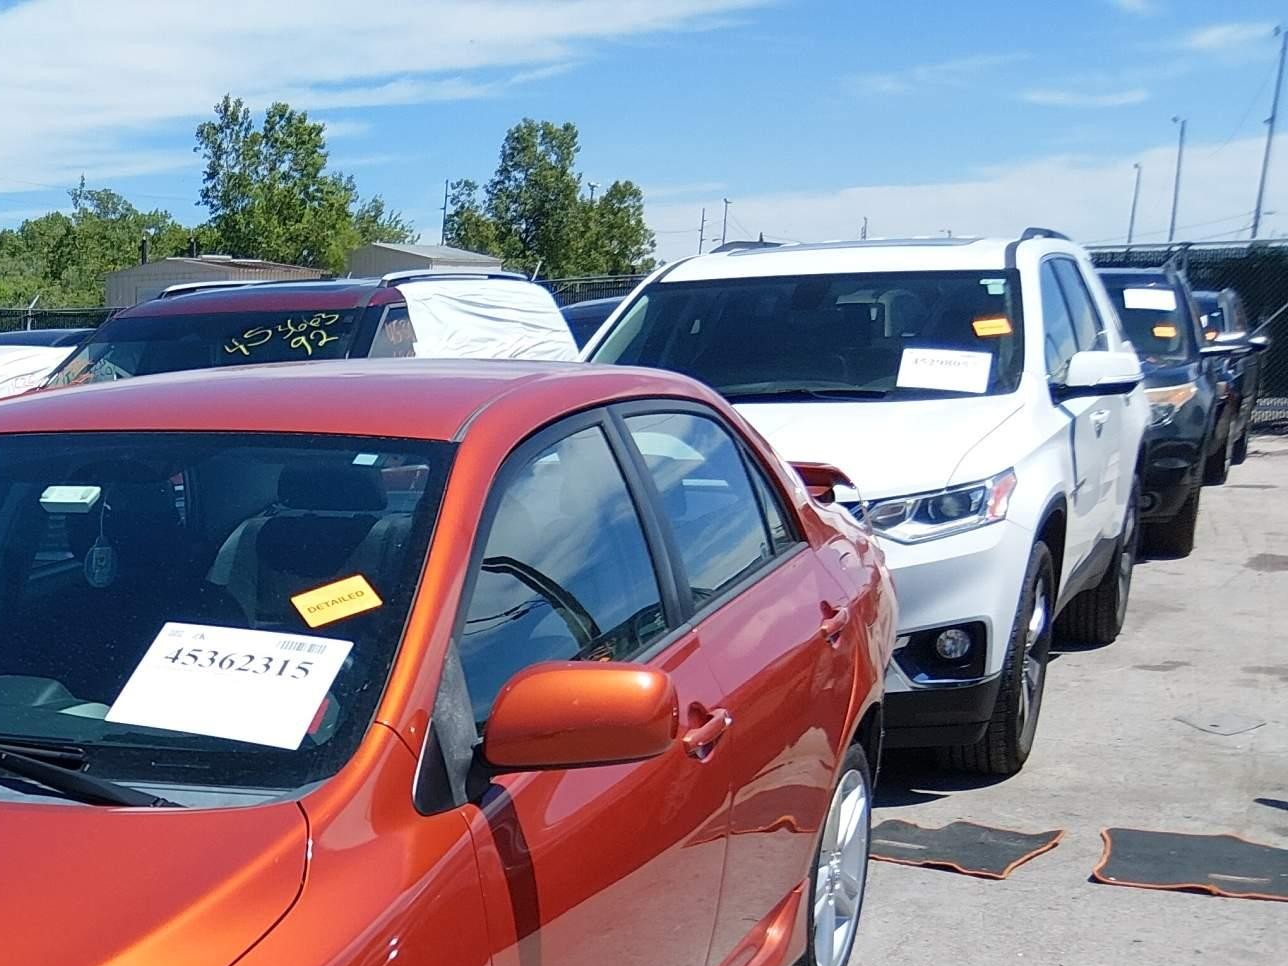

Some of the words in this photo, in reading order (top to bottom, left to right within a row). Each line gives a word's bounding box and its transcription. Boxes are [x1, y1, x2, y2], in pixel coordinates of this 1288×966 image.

[290, 329, 340, 356] 92
[307, 590, 365, 613] DETAILED
[164, 647, 314, 679] 45362315
